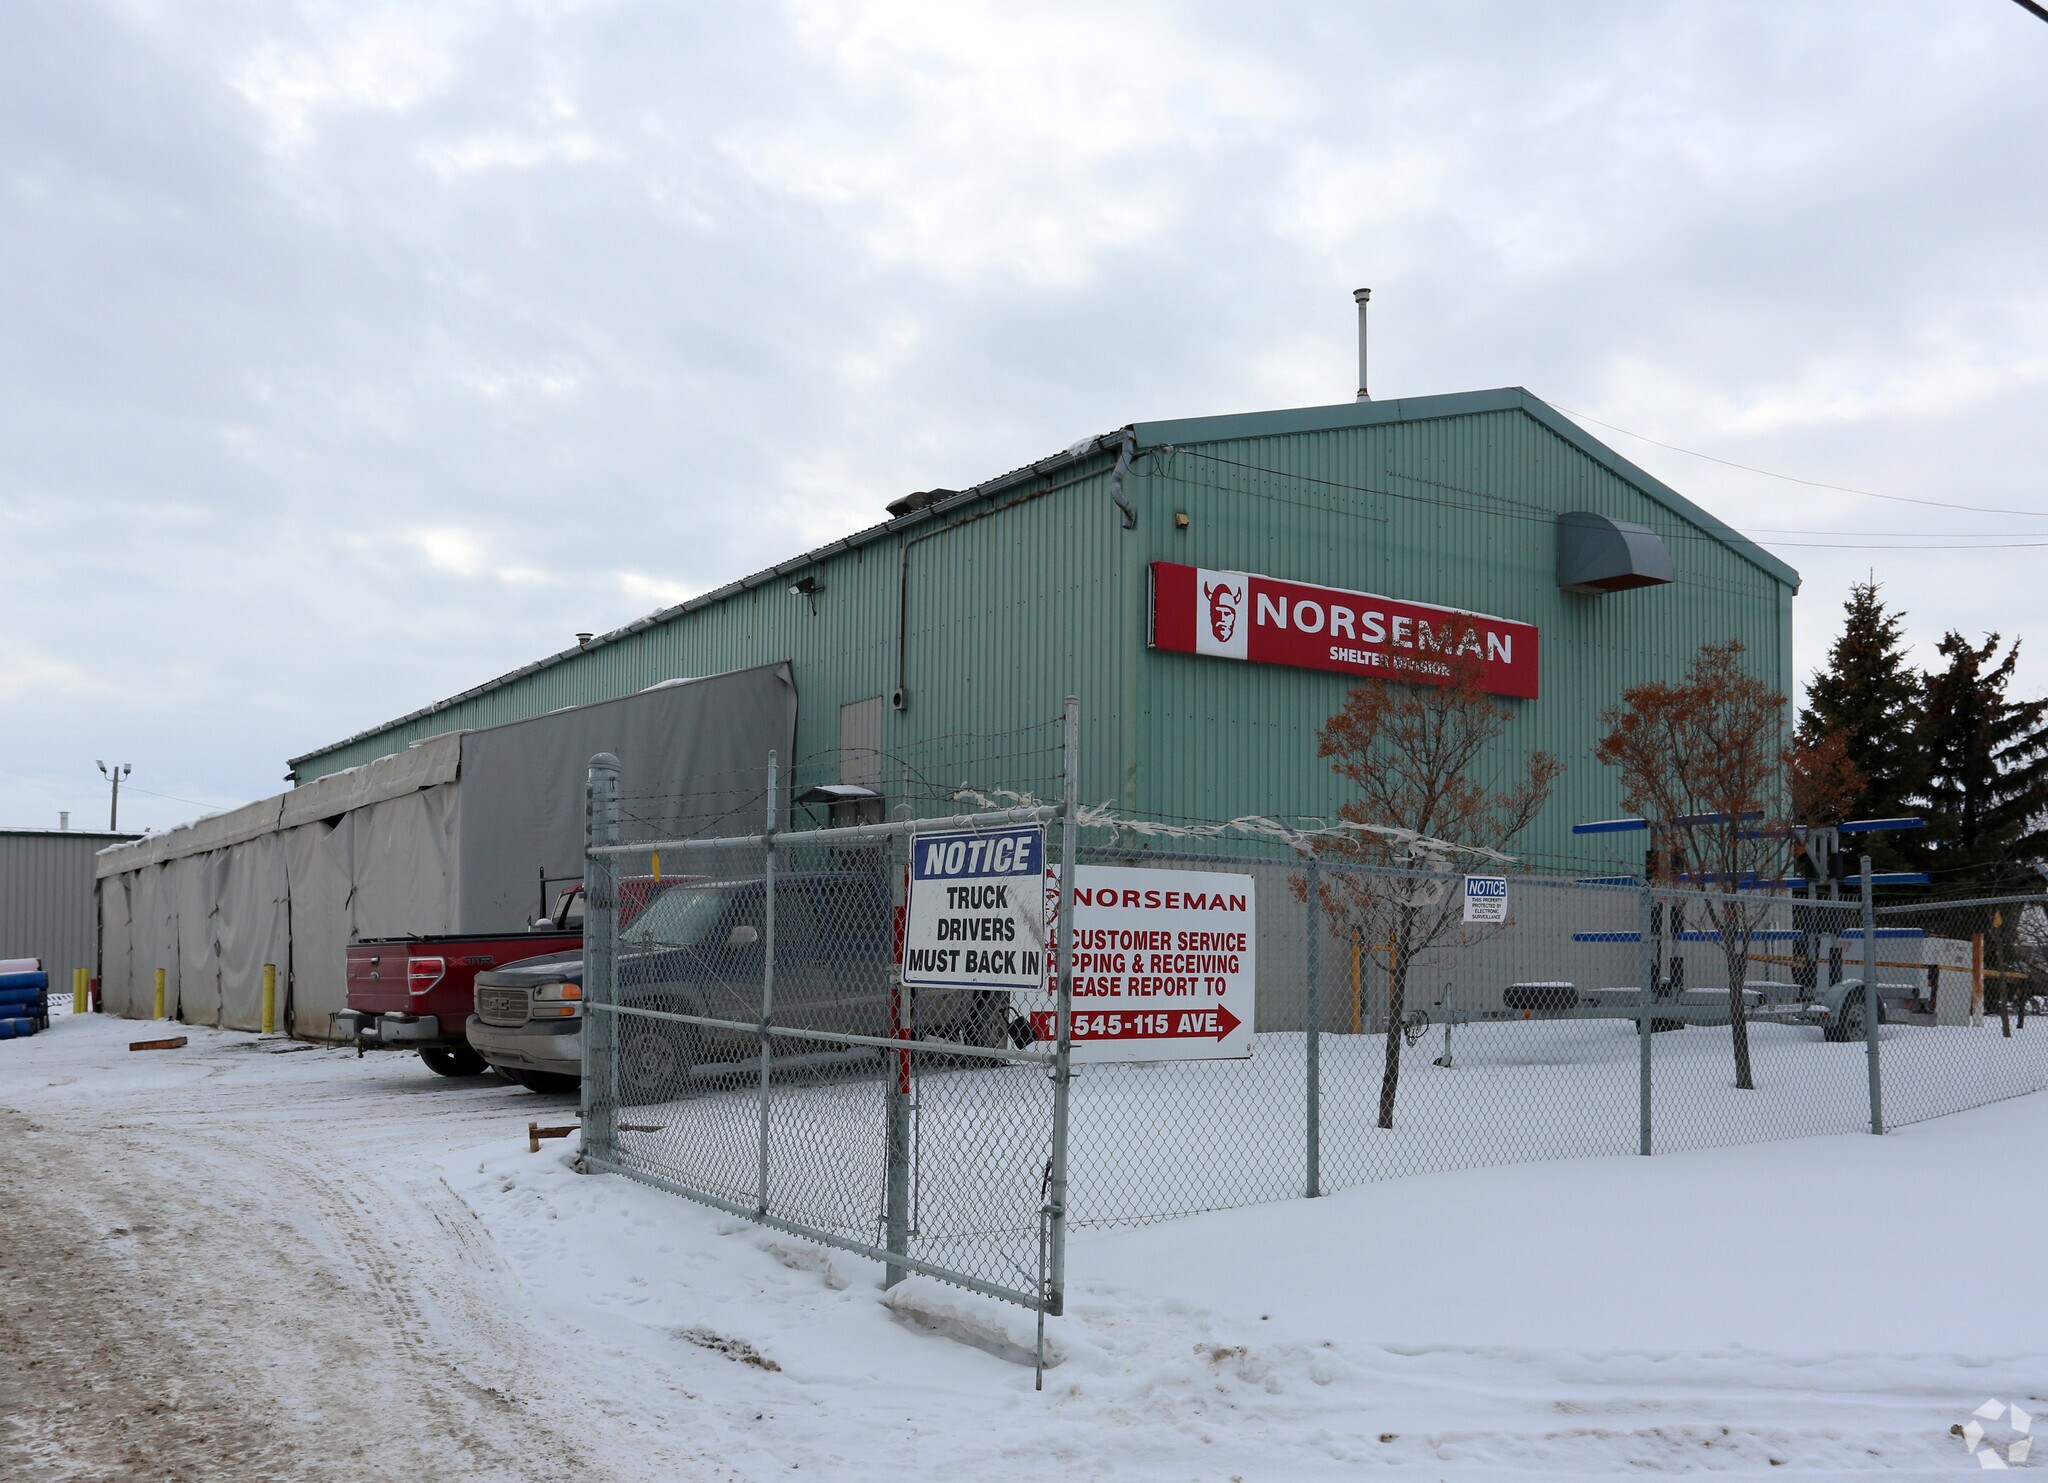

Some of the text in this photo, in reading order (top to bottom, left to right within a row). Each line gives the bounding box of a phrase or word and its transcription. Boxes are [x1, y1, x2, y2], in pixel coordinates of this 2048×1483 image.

[1257, 593, 1512, 664] NORSEMAN
[924, 836, 1032, 876] NOTICE
[947, 885, 1008, 909] TRUCK
[1469, 880, 1505, 895] NOTICE
[1074, 888, 1247, 912] NORSEMAN
[937, 917, 1015, 941] DRIVERS
[1177, 931, 1247, 952] SERVICE
[908, 949, 1040, 975] MUST BACK IN
[1132, 953, 1145, 974] &
[1150, 954, 1240, 974] RECEIVING
[1049, 976, 1227, 997] PEASE REPORT TO
[1177, 1012, 1224, 1033] AVE.
